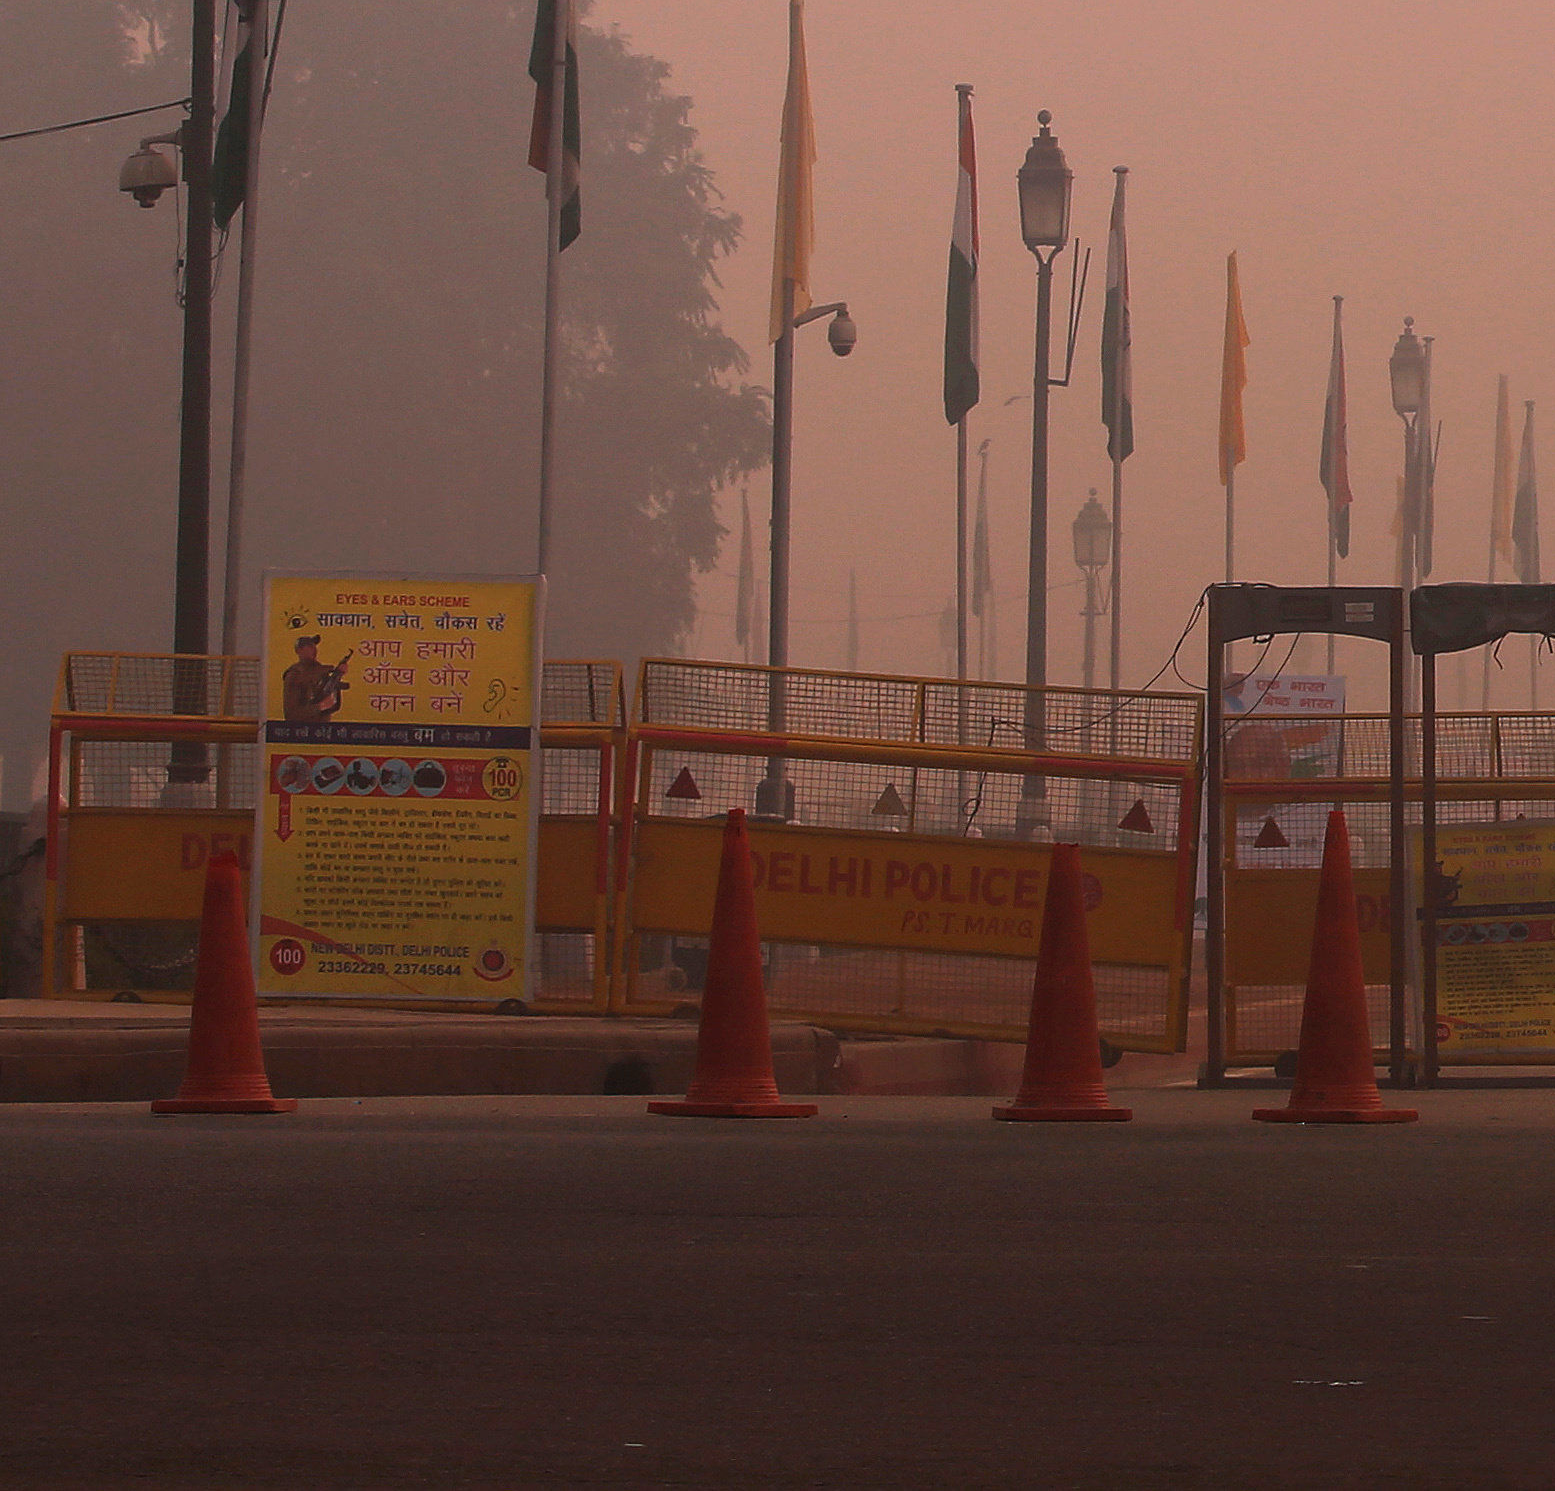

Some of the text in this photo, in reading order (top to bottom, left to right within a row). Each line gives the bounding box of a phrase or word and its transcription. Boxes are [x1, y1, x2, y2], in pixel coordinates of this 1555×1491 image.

[336, 594, 470, 608] EYES & EARS SCHEME
[433, 611, 478, 630] चौकस
[486, 613, 506, 632] रहें
[358, 636, 477, 660] आप हमारी
[428, 663, 471, 687] और
[369, 691, 464, 714] कान बनें
[412, 728, 435, 743] बम
[489, 769, 517, 787] 100
[182, 832, 258, 871] DEL
[885, 859, 1041, 911] POLICE
[275, 948, 301, 965] 100
[311, 943, 334, 954] NEW
[336, 944, 367, 956] DELHI
[402, 945, 432, 957] DELHI
[432, 946, 470, 959] POLICE
[393, 963, 461, 977] 23745644
